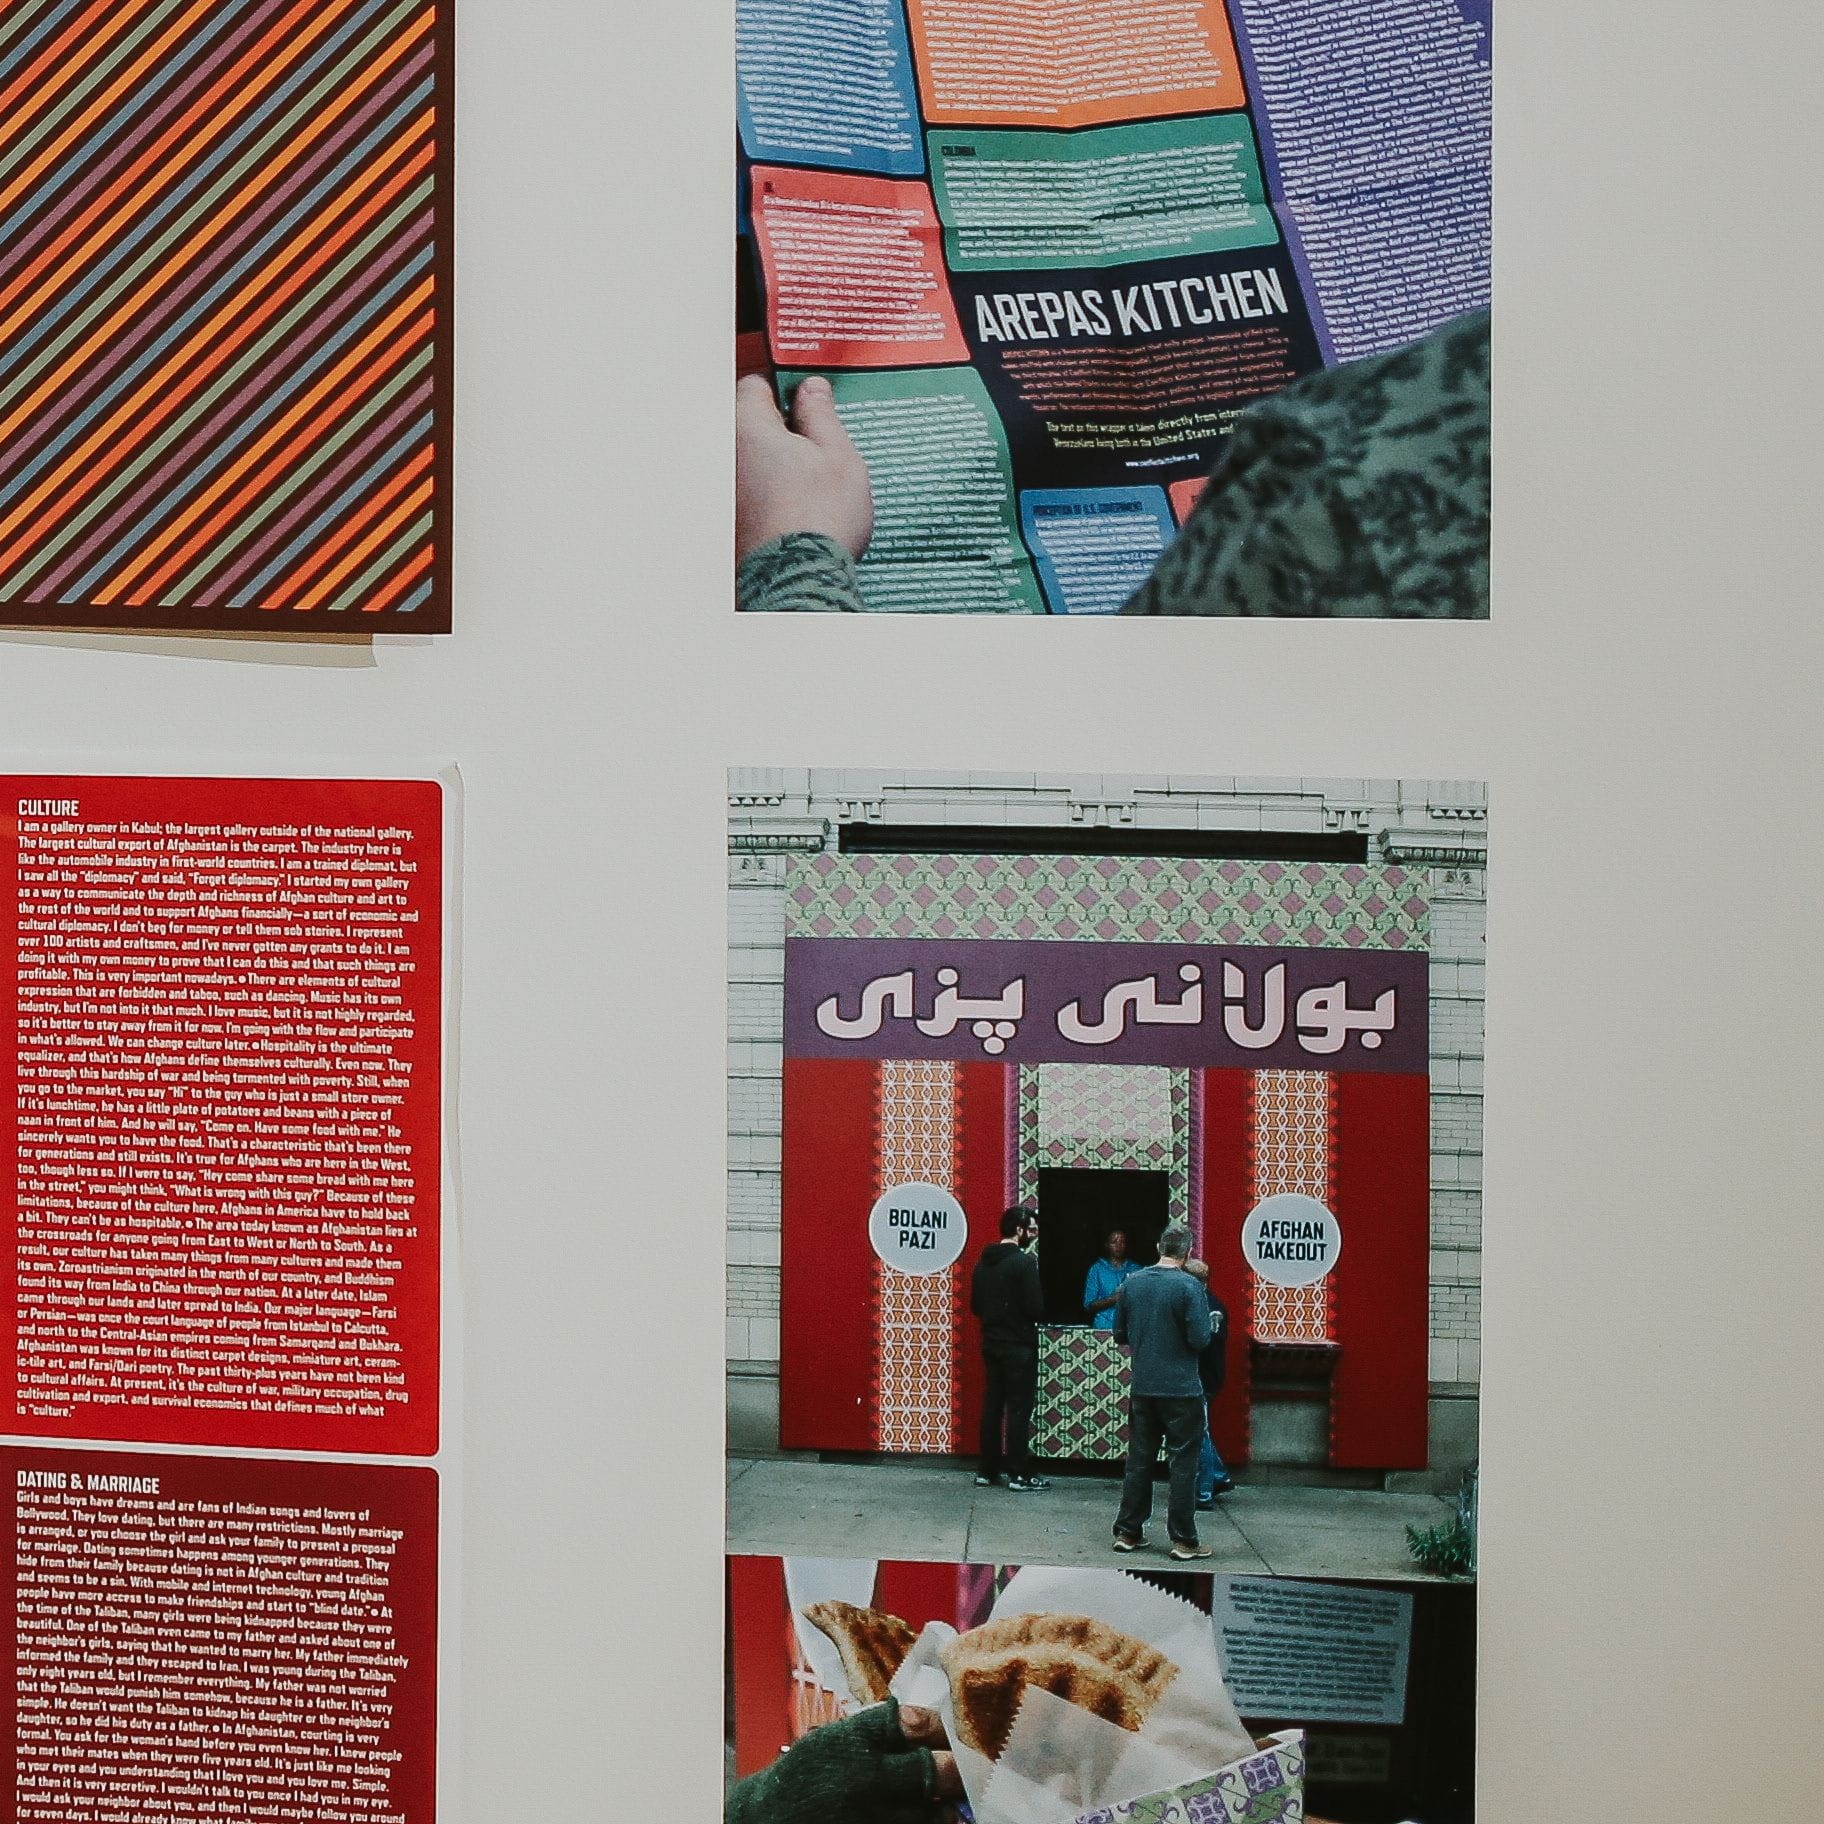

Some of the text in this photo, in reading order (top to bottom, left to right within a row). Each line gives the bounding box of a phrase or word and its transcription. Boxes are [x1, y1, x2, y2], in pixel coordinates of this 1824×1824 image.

[974, 268, 1288, 343] AREPAS KITCHEN
[1186, 428, 1216, 438] States
[18, 799, 79, 817] CULTURE
[815, 967, 1025, 1055] پزی
[888, 1208, 948, 1231] BOLANI
[1260, 1220, 1325, 1242] AFGHAN
[898, 1229, 936, 1250] PAZI
[1256, 1241, 1328, 1264] TAKEOUT
[17, 1470, 160, 1495] DATING & MARRIAGE
[16, 1490, 370, 1521] Girls and boys have dreams and are fans of Indian songs and lovers of
